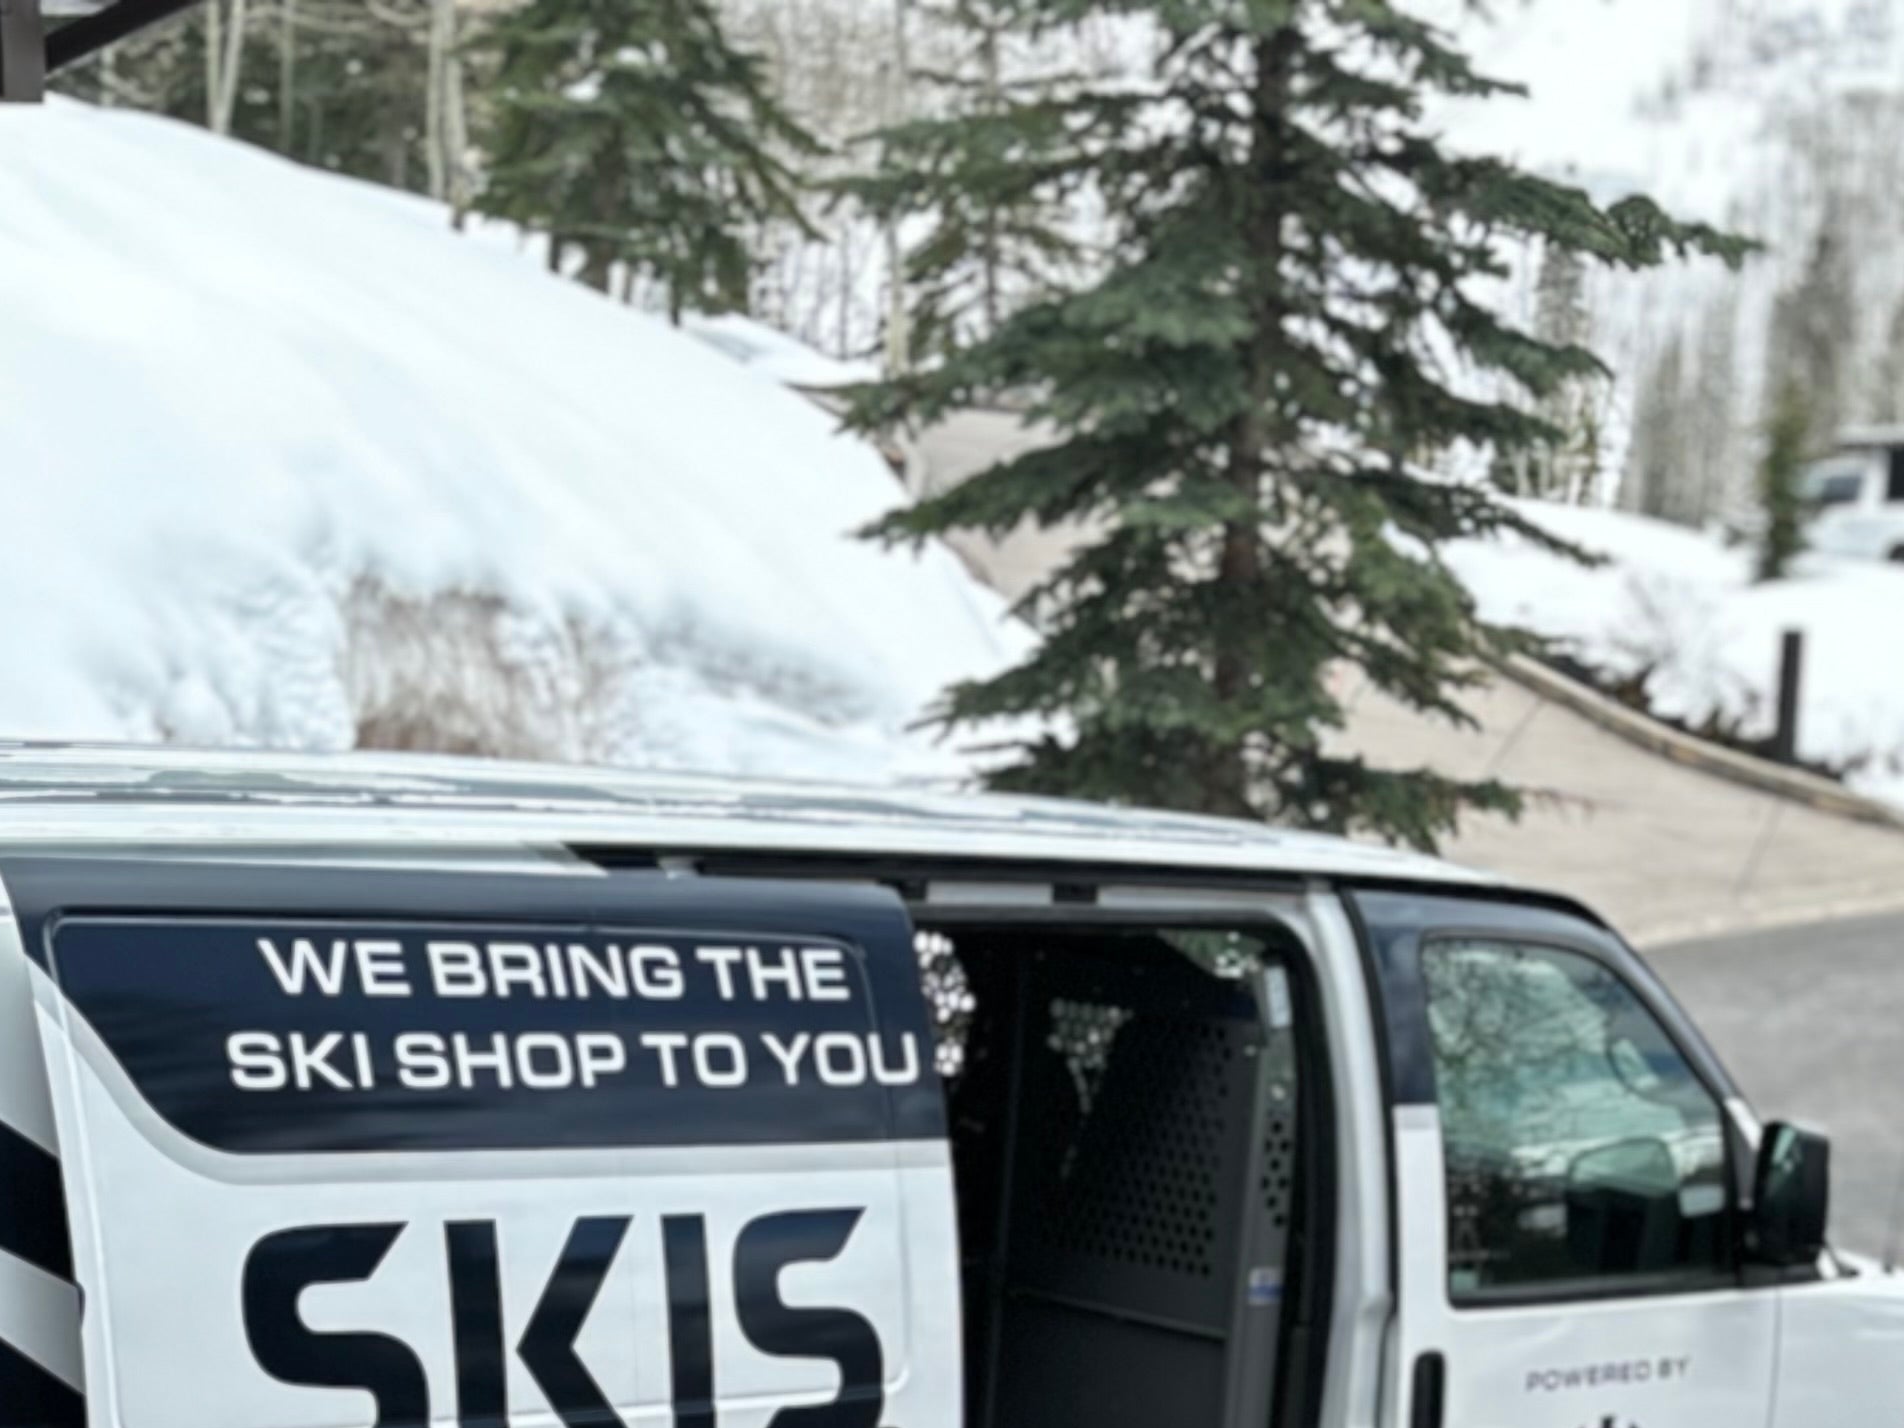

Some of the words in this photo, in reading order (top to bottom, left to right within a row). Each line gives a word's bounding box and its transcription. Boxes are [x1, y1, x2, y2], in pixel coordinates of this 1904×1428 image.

[256, 938, 412, 996] WE
[424, 940, 686, 999] BRING
[695, 945, 851, 1002] THE
[224, 1031, 375, 1091] SKI
[396, 1032, 628, 1090] SHOP
[641, 1032, 750, 1087] TO
[761, 1032, 921, 1086] YOU
[1525, 1360, 1652, 1393] POWERED
[1659, 1356, 1692, 1381] BY
